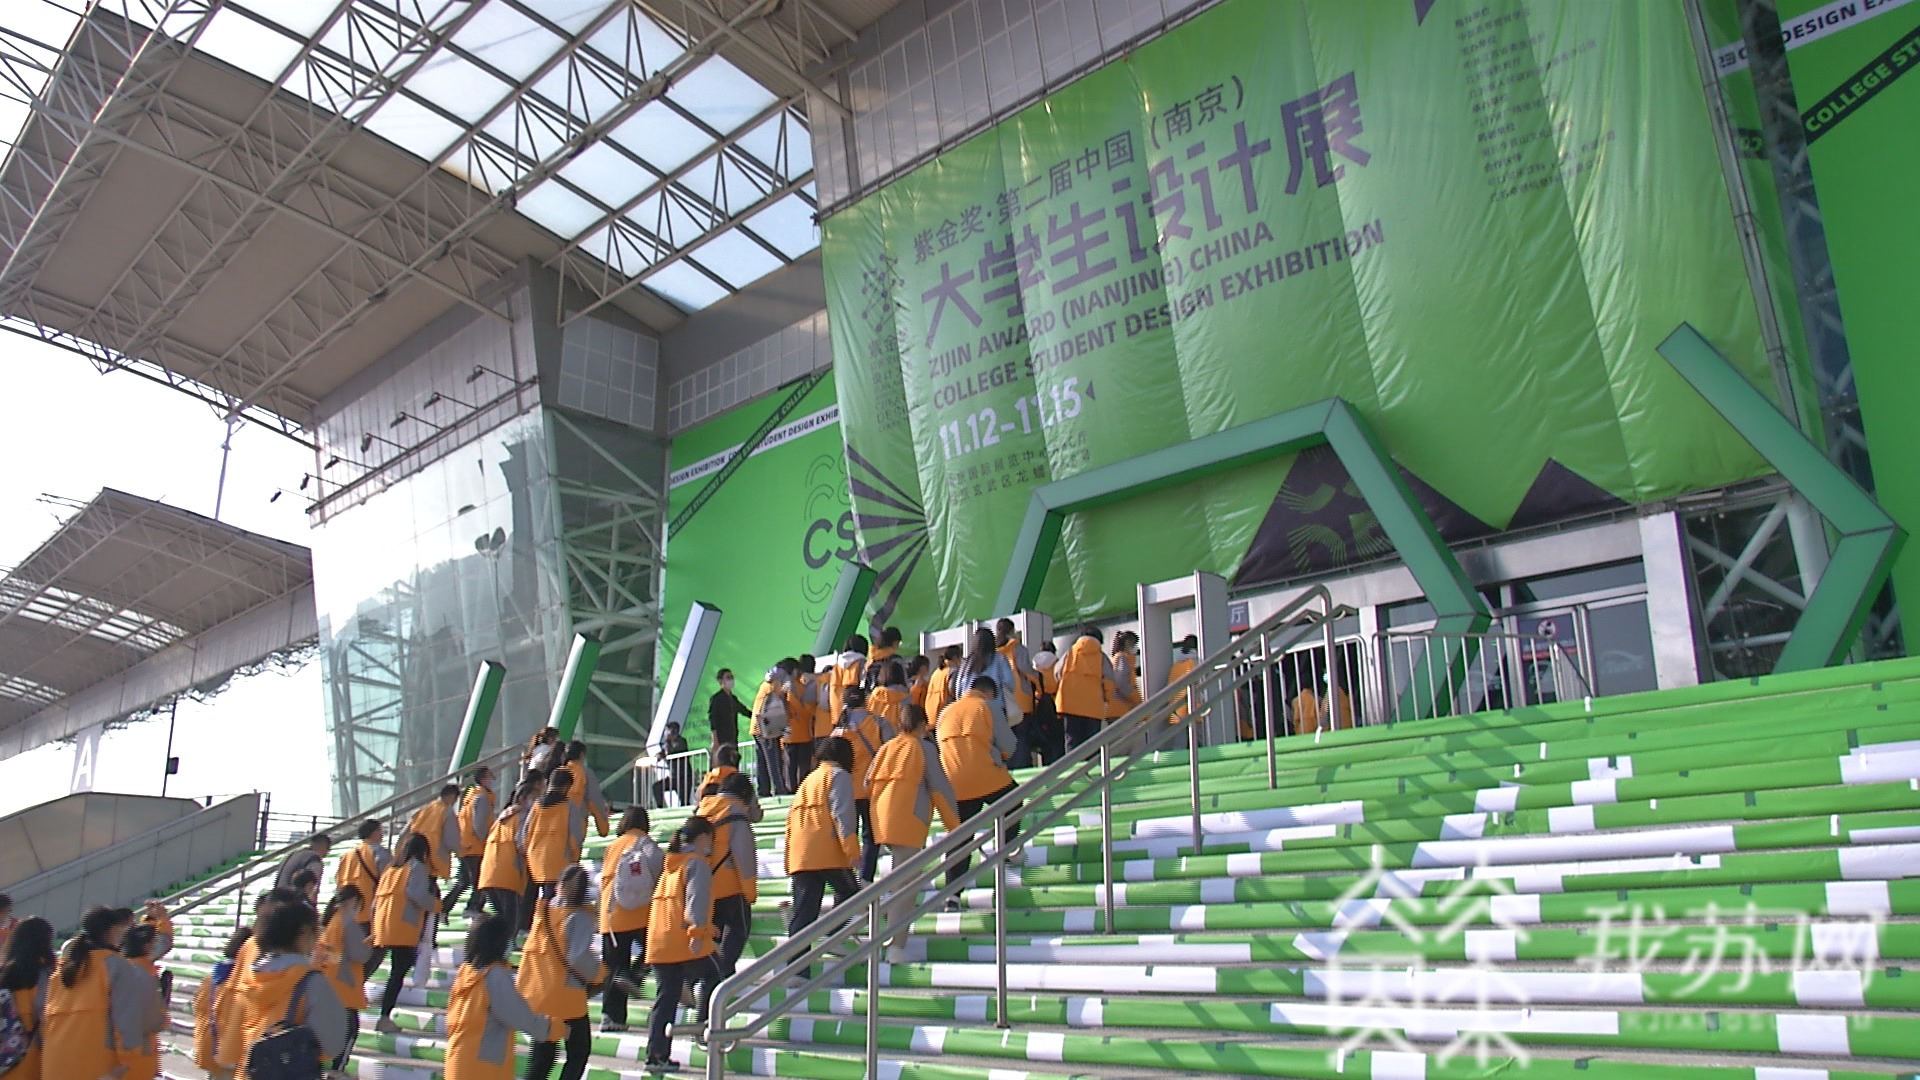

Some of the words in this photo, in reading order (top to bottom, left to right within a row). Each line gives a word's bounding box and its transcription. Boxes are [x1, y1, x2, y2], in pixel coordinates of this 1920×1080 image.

[1805, 63, 1892, 132] COLLEGE
[921, 71, 1371, 349] 大学生设计展
[928, 343, 972, 378] ZIJIN
[978, 310, 1056, 358] AWARD
[1062, 256, 1184, 328] (NANJING)
[1190, 221, 1274, 273] CHINA
[933, 360, 1019, 409] COLLEGE
[1024, 320, 1117, 377] STUDENT
[1125, 284, 1214, 337] DESIGN
[1220, 218, 1385, 301] EXHIBITION
[788, 418, 814, 436] DESIGN
[72, 734, 93, 790] A
